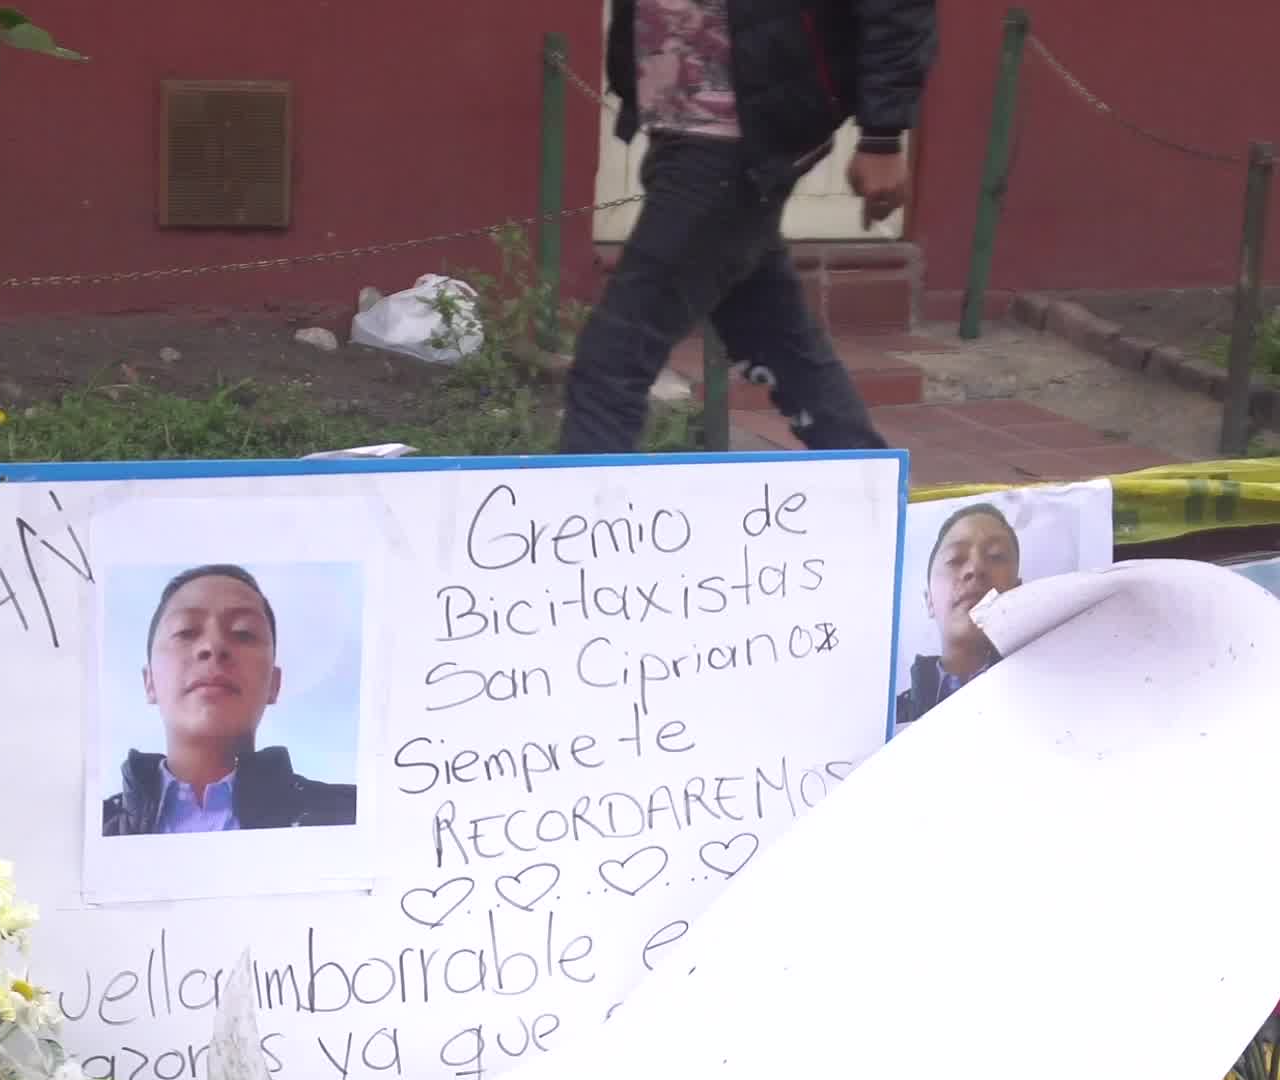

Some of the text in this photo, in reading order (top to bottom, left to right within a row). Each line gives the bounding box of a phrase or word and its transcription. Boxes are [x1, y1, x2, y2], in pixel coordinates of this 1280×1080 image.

[466, 483, 808, 570] Gremio de
[423, 661, 552, 711] San
[393, 701, 696, 794] Siempre te
[58, 927, 223, 1026] uella
[439, 1012, 562, 1077] que
